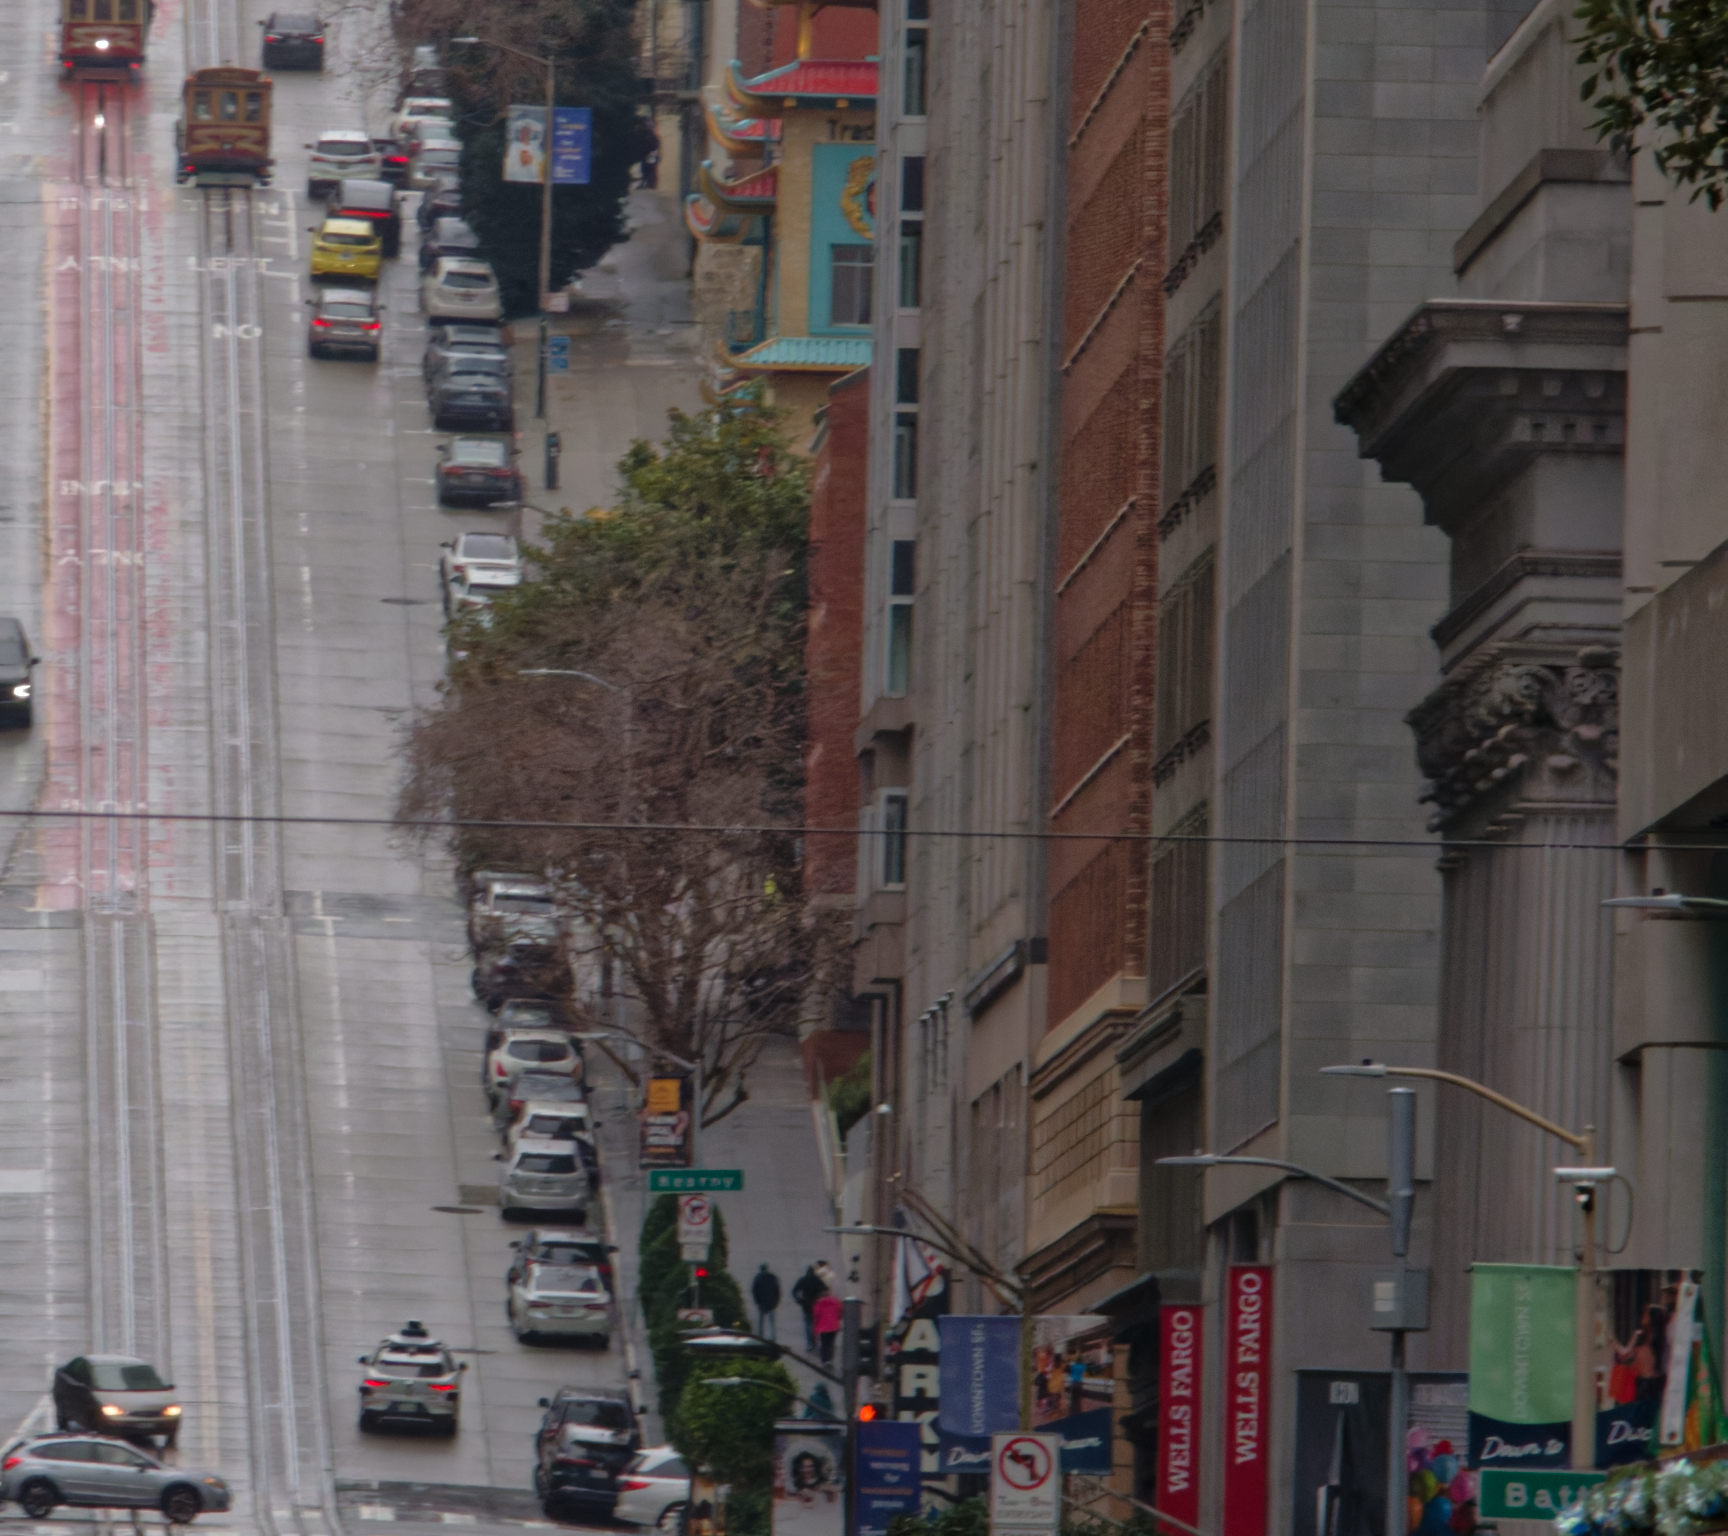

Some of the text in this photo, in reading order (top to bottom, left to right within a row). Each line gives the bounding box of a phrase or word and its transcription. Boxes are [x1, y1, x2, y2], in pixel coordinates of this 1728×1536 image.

[1168, 1311, 1194, 1493] WELLS FARGO
[1235, 1272, 1262, 1465] WELLS FARGO
